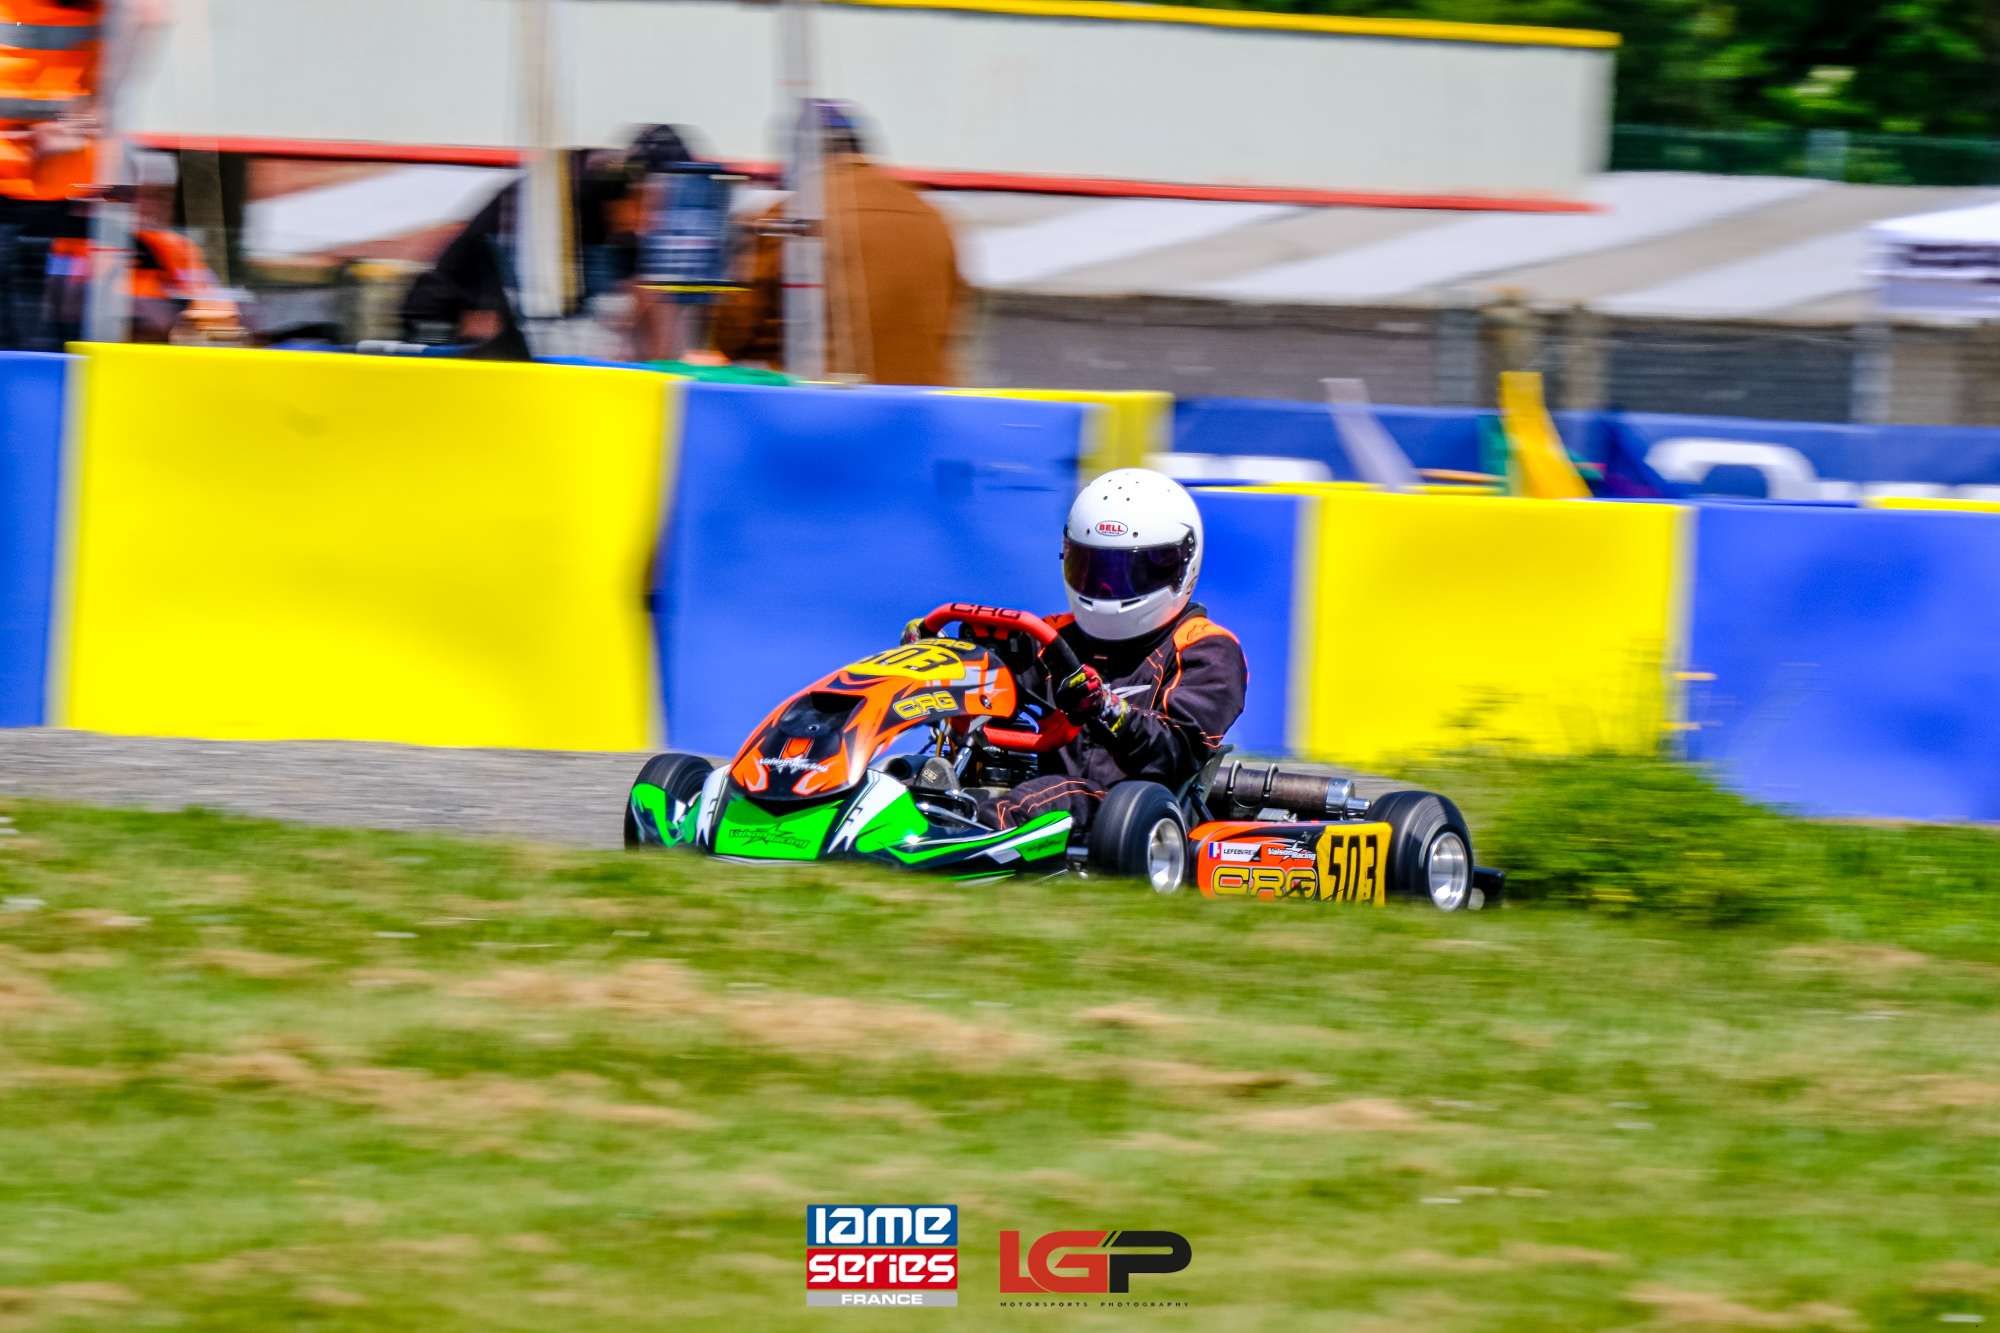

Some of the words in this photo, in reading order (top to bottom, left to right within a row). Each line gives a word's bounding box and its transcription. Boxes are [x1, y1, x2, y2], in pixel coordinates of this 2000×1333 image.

[1099, 524, 1124, 532] BELL
[951, 603, 1021, 620] CRG
[893, 691, 959, 720] CRG
[1212, 866, 1317, 898] CRG
[1328, 834, 1378, 901] 503
